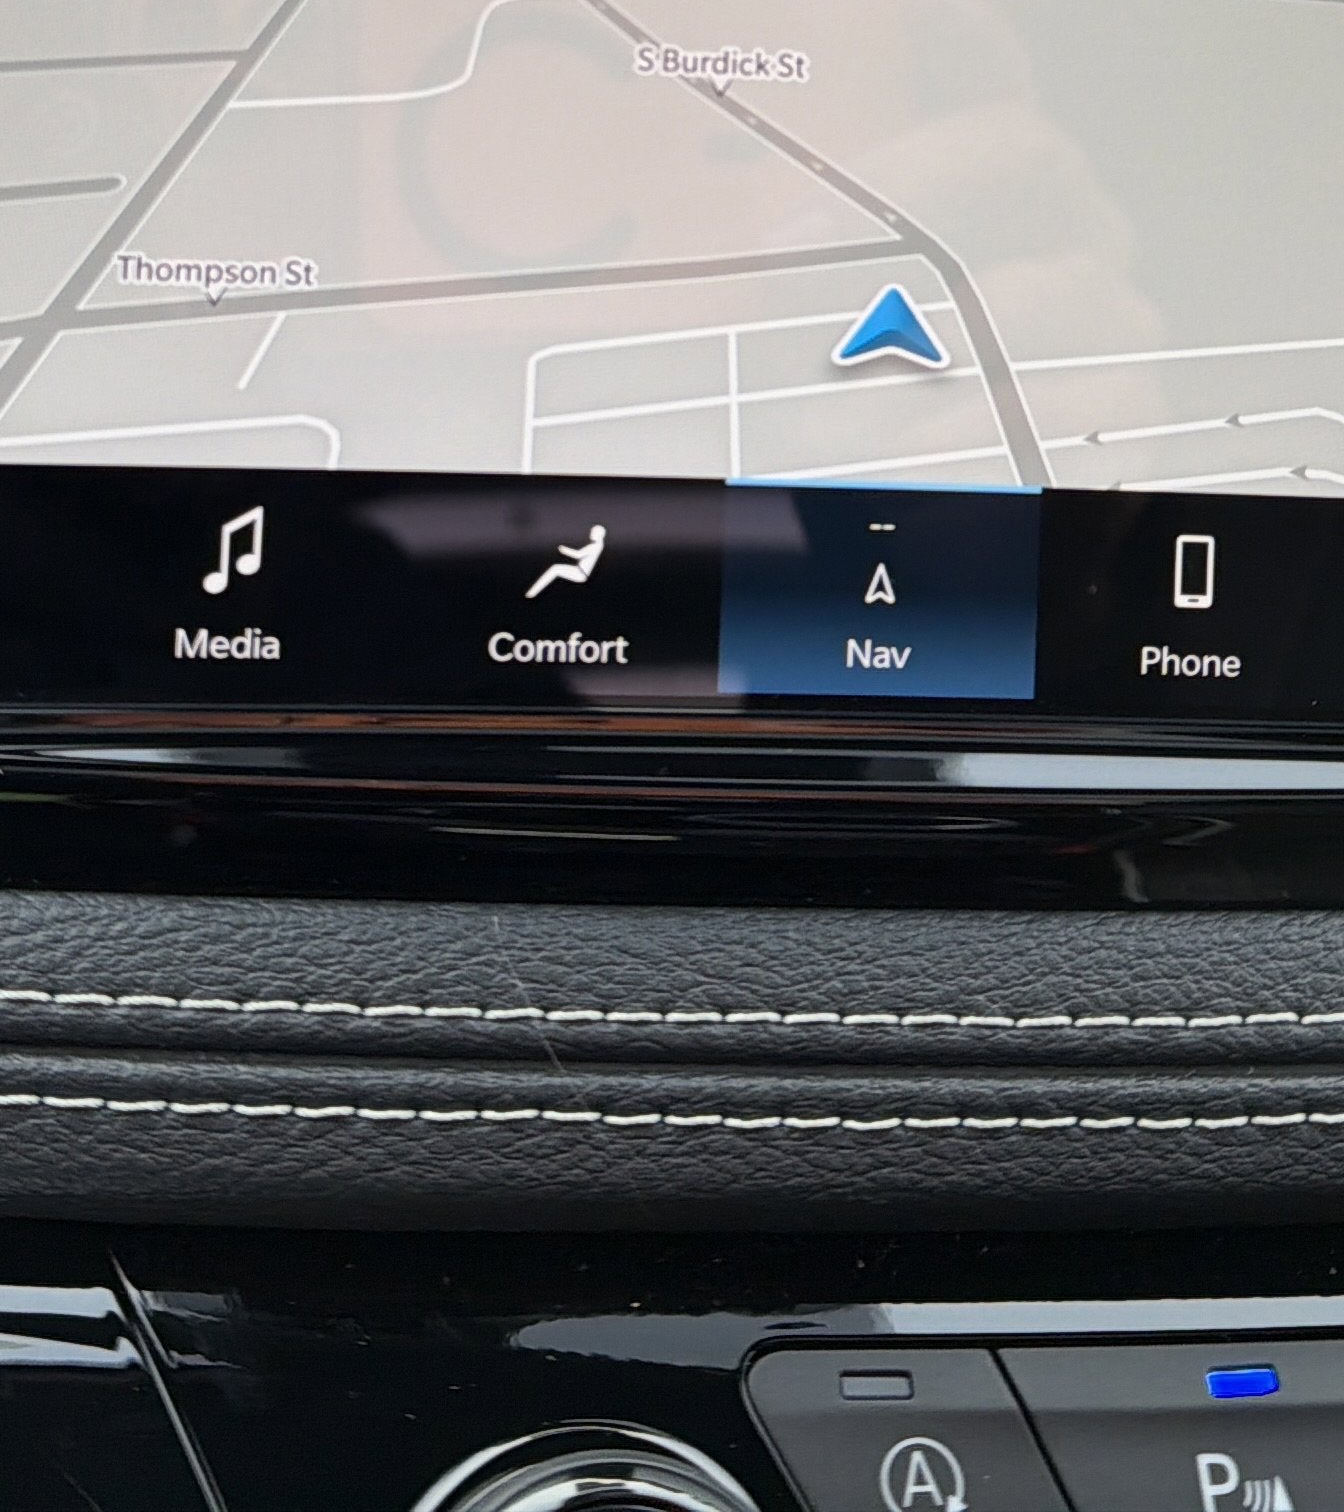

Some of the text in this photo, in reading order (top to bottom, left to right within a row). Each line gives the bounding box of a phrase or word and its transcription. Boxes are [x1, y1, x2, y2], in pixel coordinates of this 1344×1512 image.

[638, 48, 805, 79] S Burdick St
[118, 256, 316, 286] Thompson St
[174, 627, 281, 662] Media
[488, 631, 629, 665] Comfort
[846, 639, 912, 671] Nav
[1140, 645, 1242, 680] Phone
